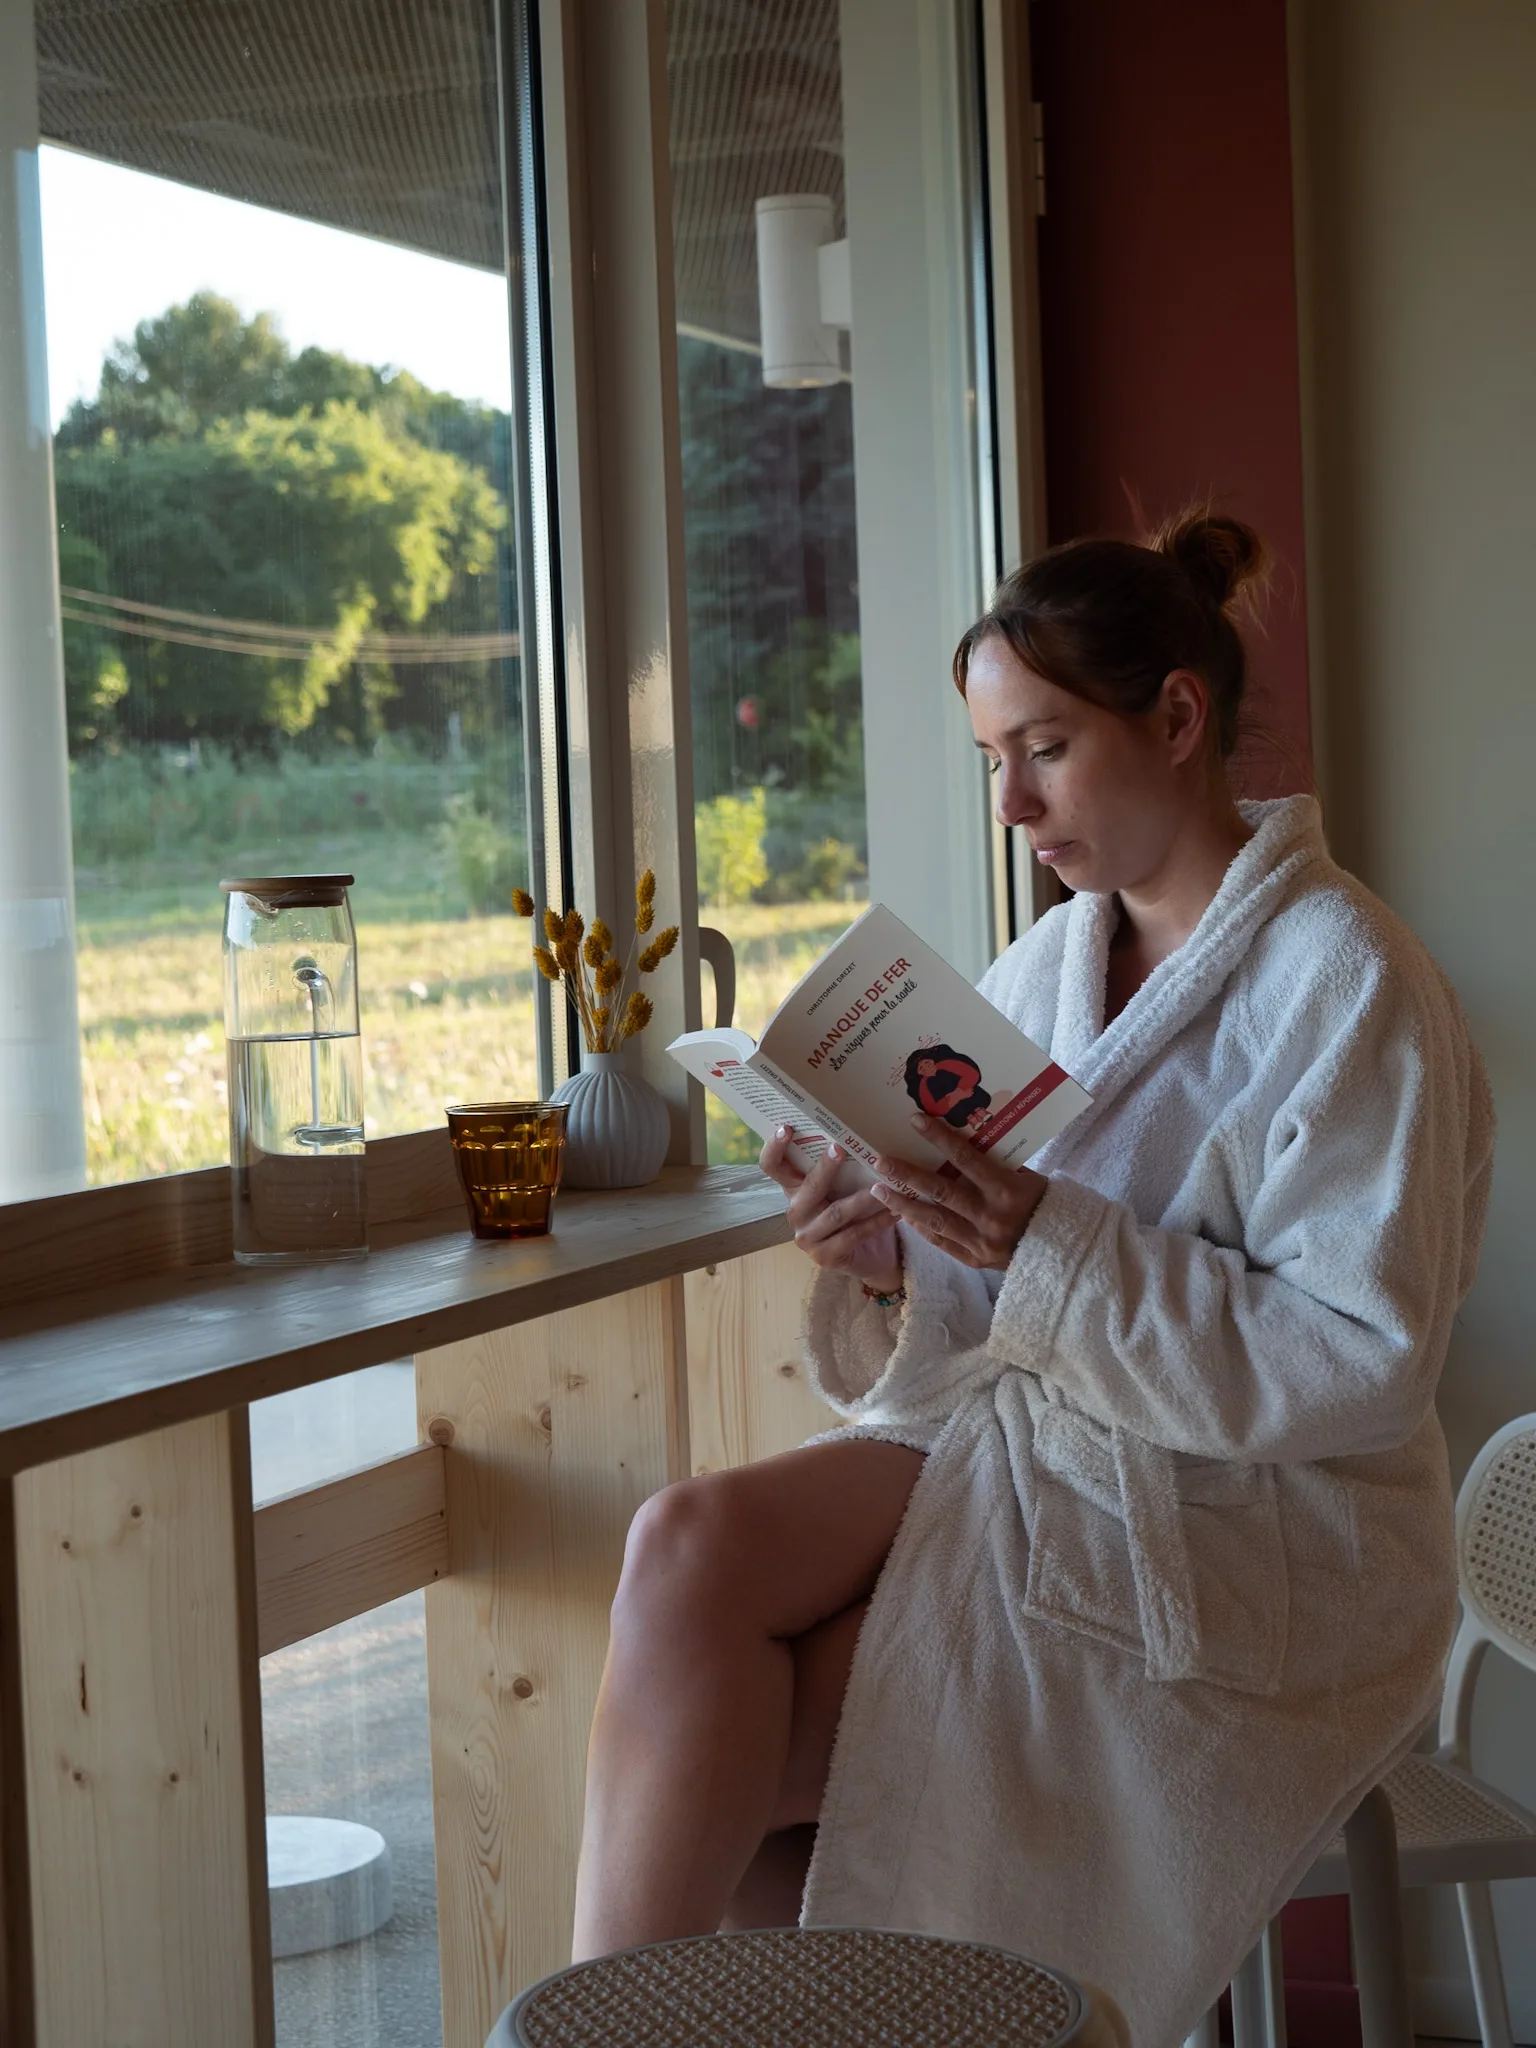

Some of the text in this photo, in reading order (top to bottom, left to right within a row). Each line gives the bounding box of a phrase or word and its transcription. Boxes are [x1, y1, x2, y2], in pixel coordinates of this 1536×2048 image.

[807, 962, 857, 1016] CHRISTOPHE DREZET
[807, 957, 912, 1069] MANQUE DE FER
[829, 978, 918, 1071] Les risques pour la santé
[844, 1135, 864, 1153] FER
[861, 1151, 878, 1165] DE
[887, 1176, 920, 1200] MAN
